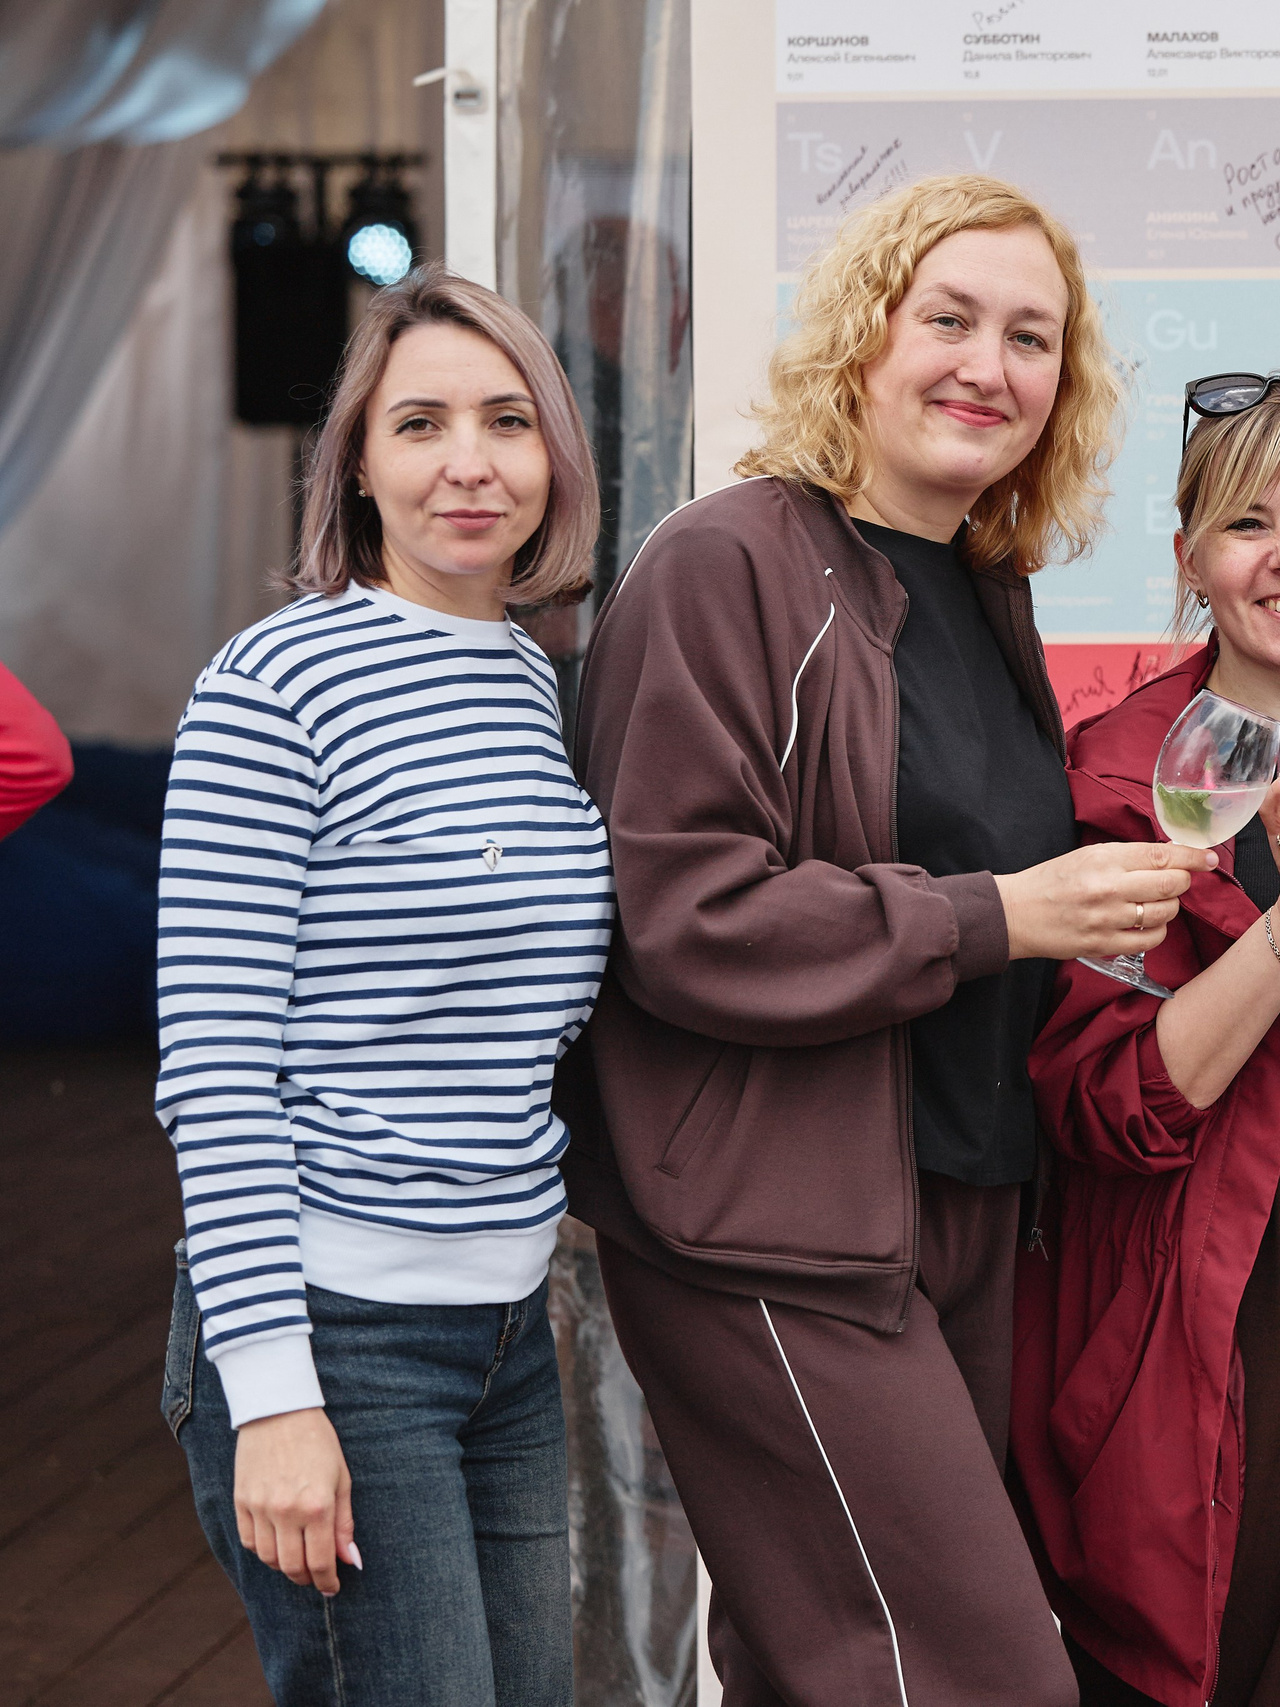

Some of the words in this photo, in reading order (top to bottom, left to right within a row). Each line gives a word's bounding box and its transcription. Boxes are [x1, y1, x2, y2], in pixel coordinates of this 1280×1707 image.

[786, 34, 870, 48] КОРШУНОВ
[962, 32, 1041, 46] СУББОТИН
[1146, 31, 1219, 43] МАЛАХОВ
[786, 52, 841, 64] Алексей
[962, 50, 1012, 64] Данила
[1015, 50, 1092, 63] Викторович
[1146, 47, 1216, 61] Александр
[786, 133, 843, 174] Ts
[962, 131, 1003, 172] V
[1147, 128, 1217, 171] An
[1145, 309, 1219, 352] Gu
